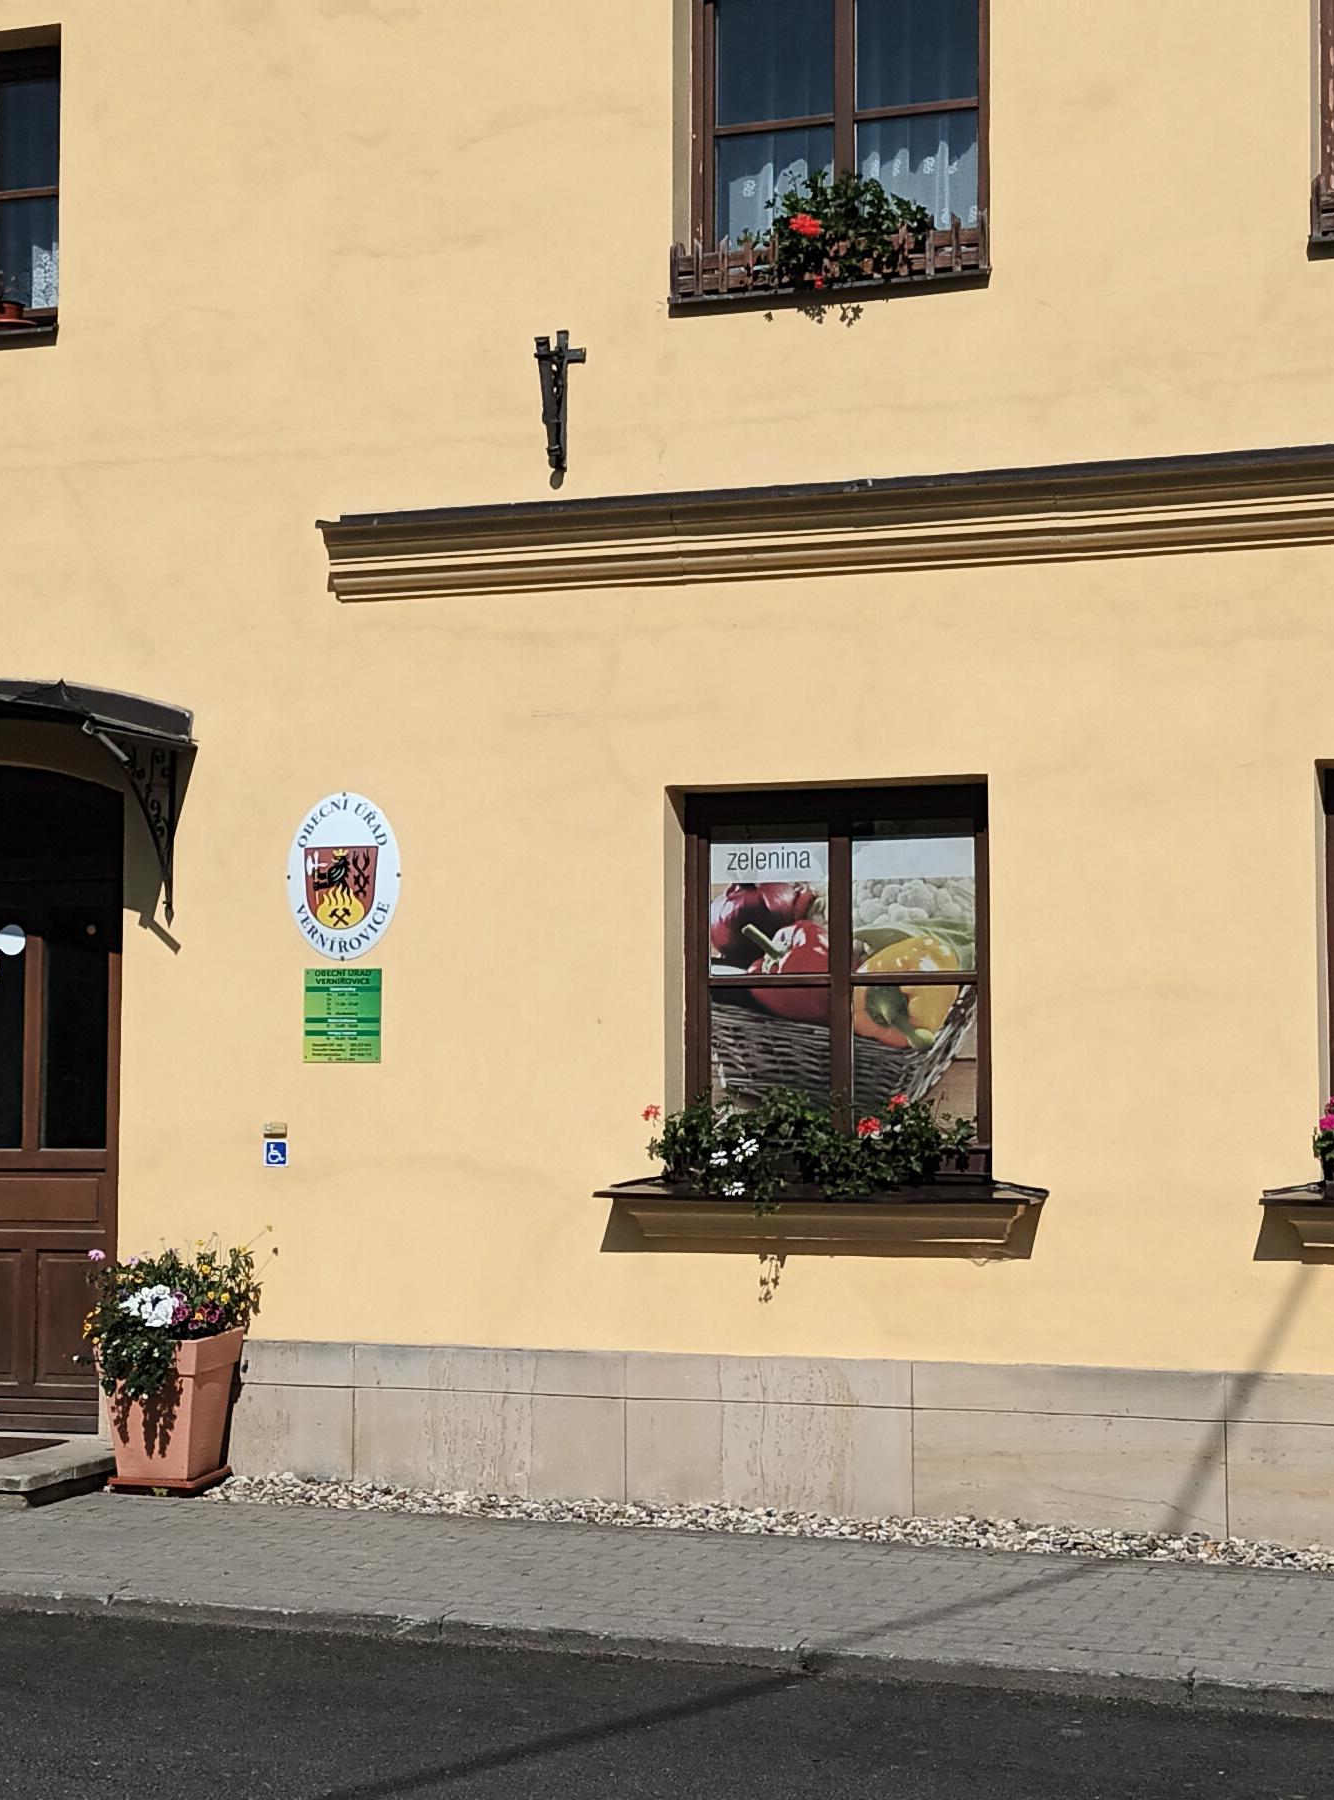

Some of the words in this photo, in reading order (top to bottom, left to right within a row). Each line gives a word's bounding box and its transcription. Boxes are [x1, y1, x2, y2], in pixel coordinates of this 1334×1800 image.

[297, 798, 349, 847] OBECNÍ
[354, 802, 388, 847] ÚŘAD
[727, 846, 811, 871] zelenina
[296, 901, 390, 953] VERNÍŘOVICE
